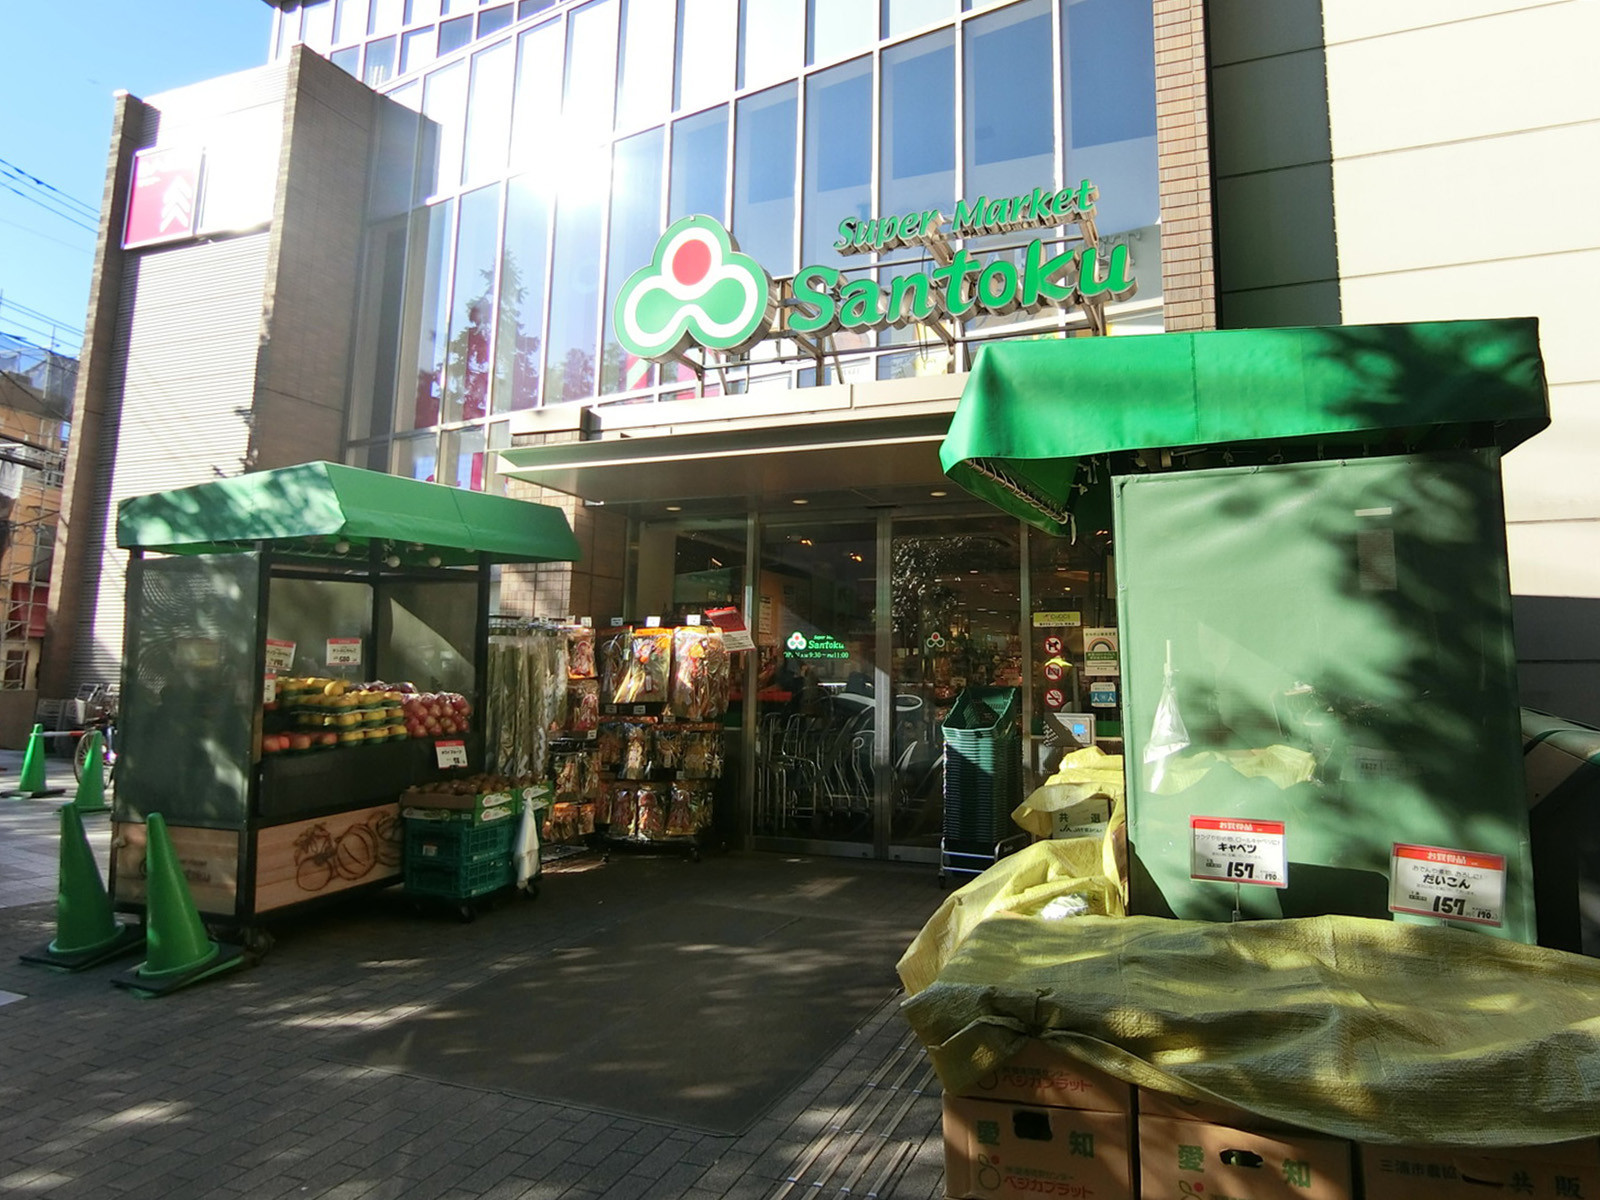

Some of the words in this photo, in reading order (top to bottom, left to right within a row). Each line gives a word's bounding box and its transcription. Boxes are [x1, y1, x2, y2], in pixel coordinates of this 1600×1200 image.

[833, 209, 942, 250] Super
[952, 179, 1097, 231] Market
[787, 238, 1136, 332] Santoku
[808, 640, 845, 650] Santoku
[1218, 842, 1257, 854] キャベツ
[1427, 851, 1467, 865] お買得品
[1227, 861, 1255, 879] 157
[1423, 874, 1471, 889] だいこん
[1432, 895, 1466, 916] 157
